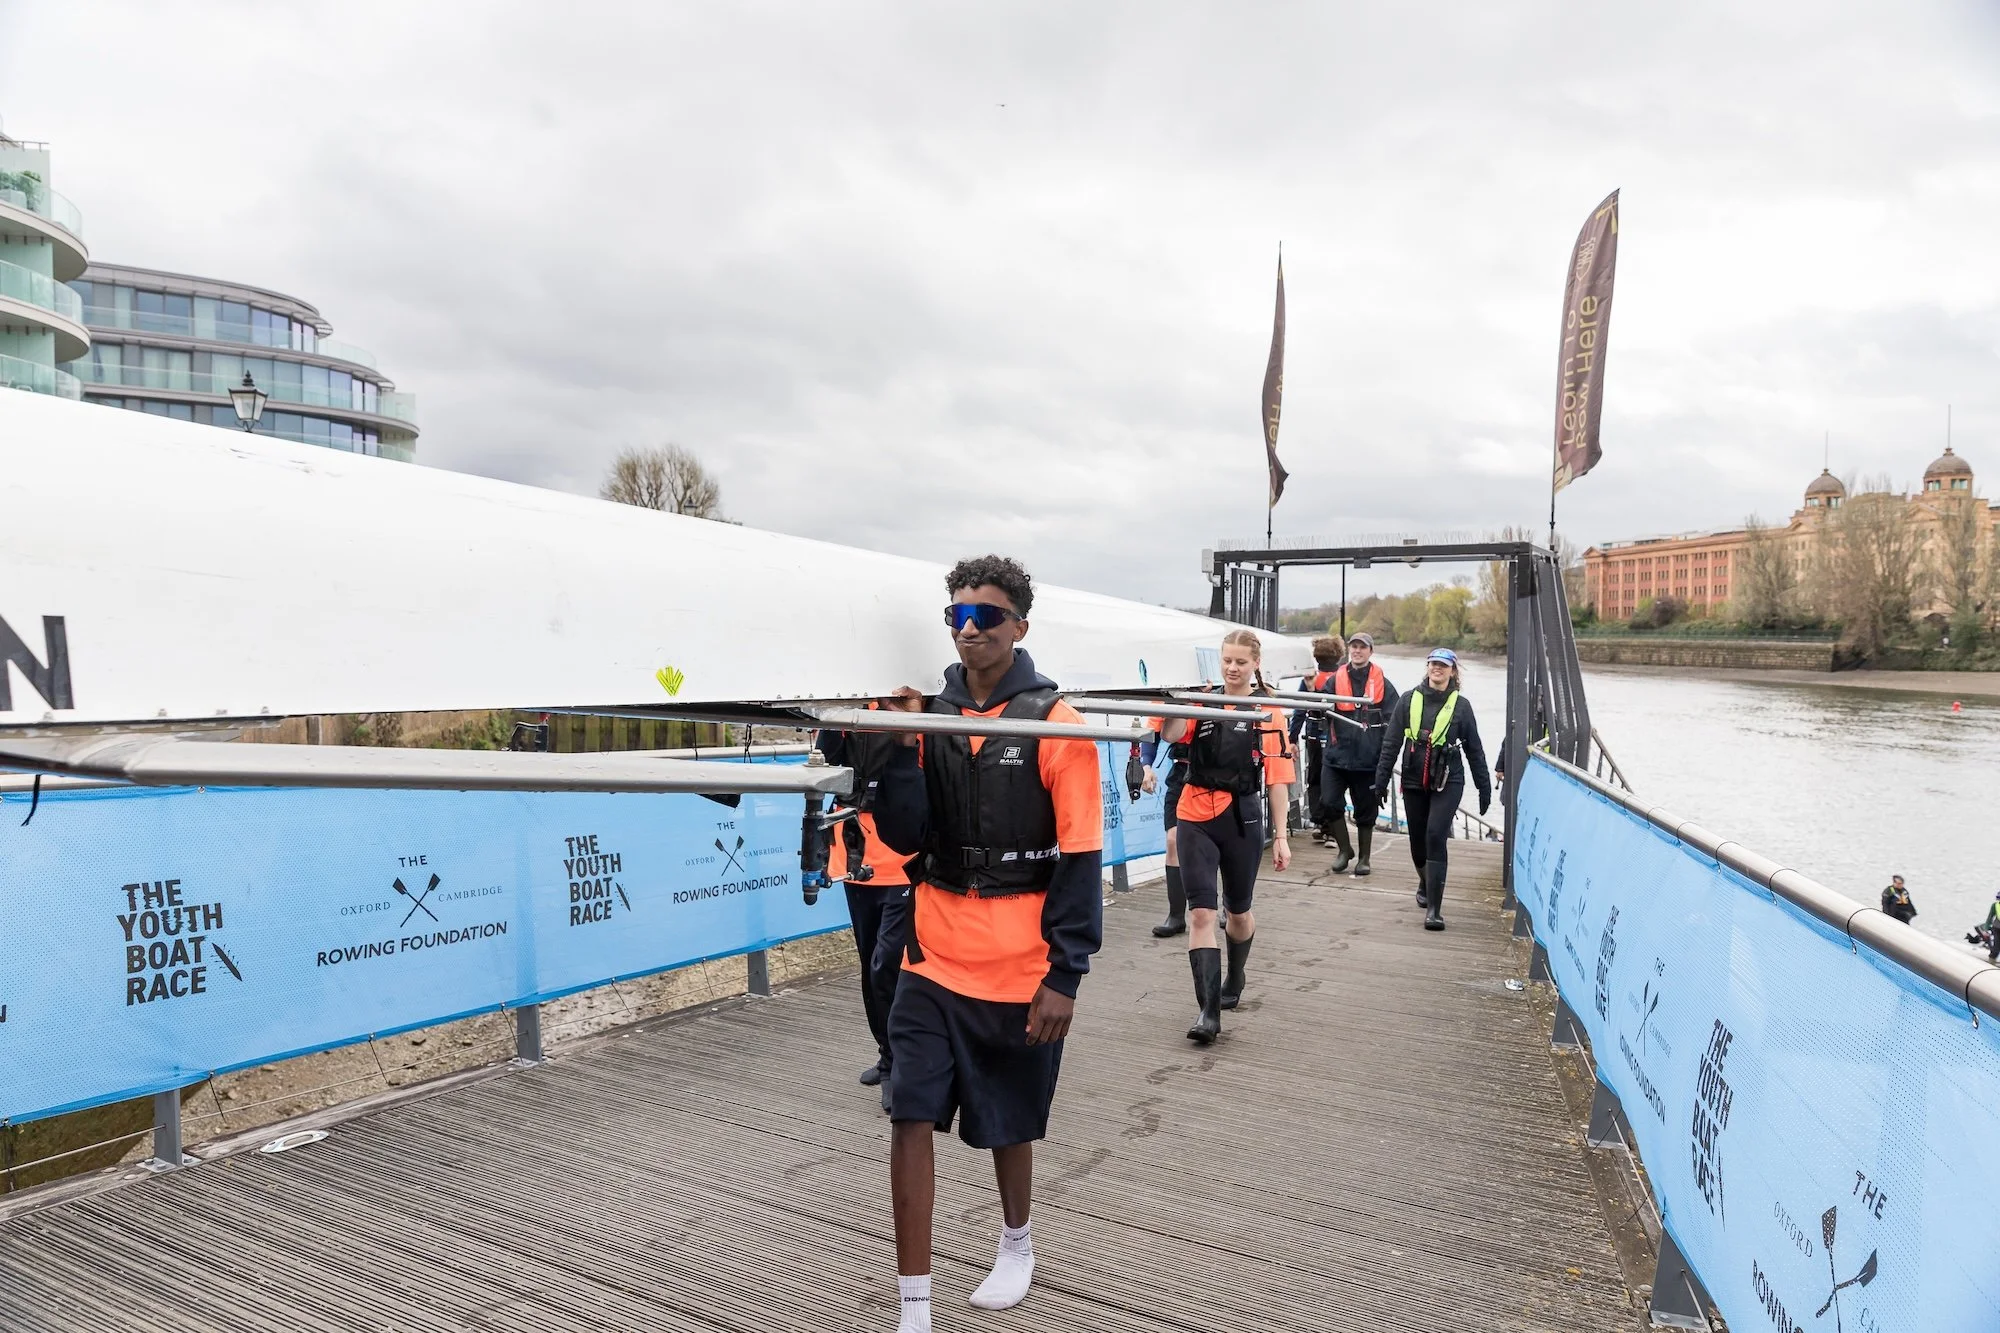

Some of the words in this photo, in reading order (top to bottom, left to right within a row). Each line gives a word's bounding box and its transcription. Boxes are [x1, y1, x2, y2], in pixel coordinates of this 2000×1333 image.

[1576, 295, 1598, 373] Here
[1563, 357, 1577, 444] Learn
[1576, 383, 1590, 449] Row
[564, 834, 600, 857] THE
[717, 821, 735, 831] THE
[398, 855, 428, 868] THE
[563, 853, 622, 880] YOUTH
[685, 856, 716, 866] OXFORD
[743, 846, 784, 858] CAMBRIDGE
[121, 879, 183, 912] THE
[341, 901, 391, 916] OXFORD
[438, 886, 503, 902] CAMBRIDGE
[569, 877, 613, 903] BOAT
[673, 885, 719, 904] ROWING
[722, 874, 788, 896] FOUNDATION
[117, 902, 223, 942] YOUTH
[570, 900, 613, 927] RACE
[126, 935, 207, 974] BOAT
[317, 940, 395, 967] ROWING
[401, 921, 508, 952] FOUNDATION
[126, 966, 207, 1007] RACE
[1654, 956, 1666, 978] THE
[1707, 1018, 1734, 1073] THE
[1633, 1057, 1666, 1126] FOUNDATION
[1696, 1053, 1734, 1131] YOUTH
[1692, 1098, 1719, 1167] BOAT
[1692, 1141, 1715, 1216] RACE
[1852, 1170, 1888, 1221] THE
[1773, 1201, 1813, 1258] OXFORD
[1753, 1258, 1804, 1333] ROWIN
